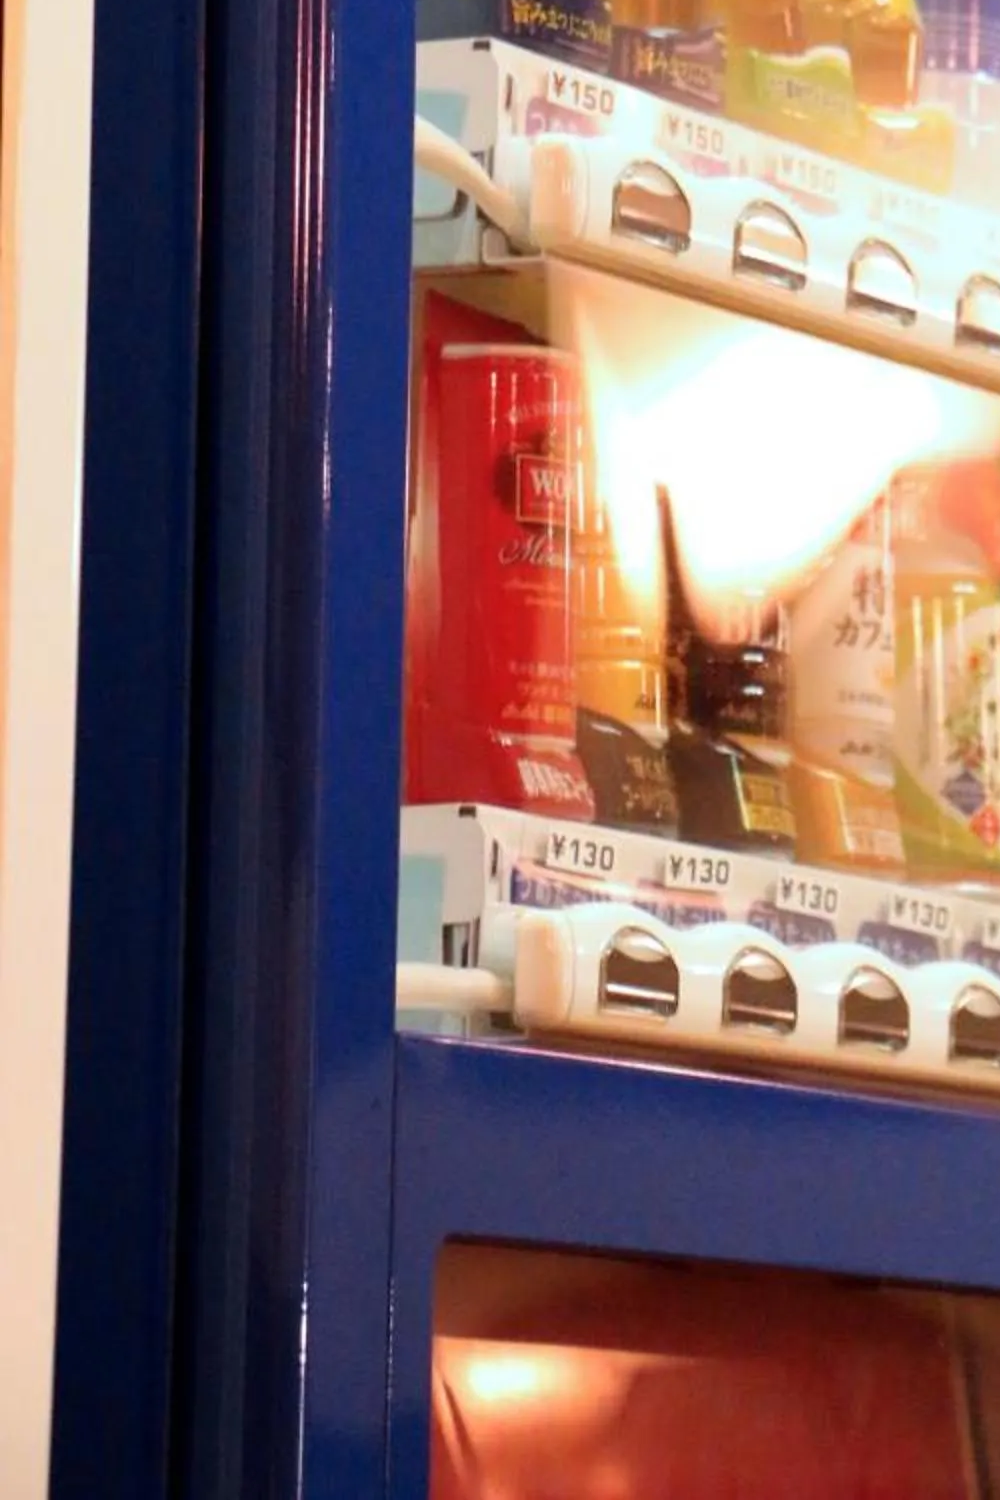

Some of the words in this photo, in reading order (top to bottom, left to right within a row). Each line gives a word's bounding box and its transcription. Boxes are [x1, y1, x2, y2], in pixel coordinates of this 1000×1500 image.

[553, 70, 616, 116] ¥150
[667, 111, 725, 154] ¥150
[552, 833, 615, 871] ¥130
[669, 854, 730, 886] ¥130
[780, 876, 838, 914] ¥130
[893, 894, 950, 931] ¥130
